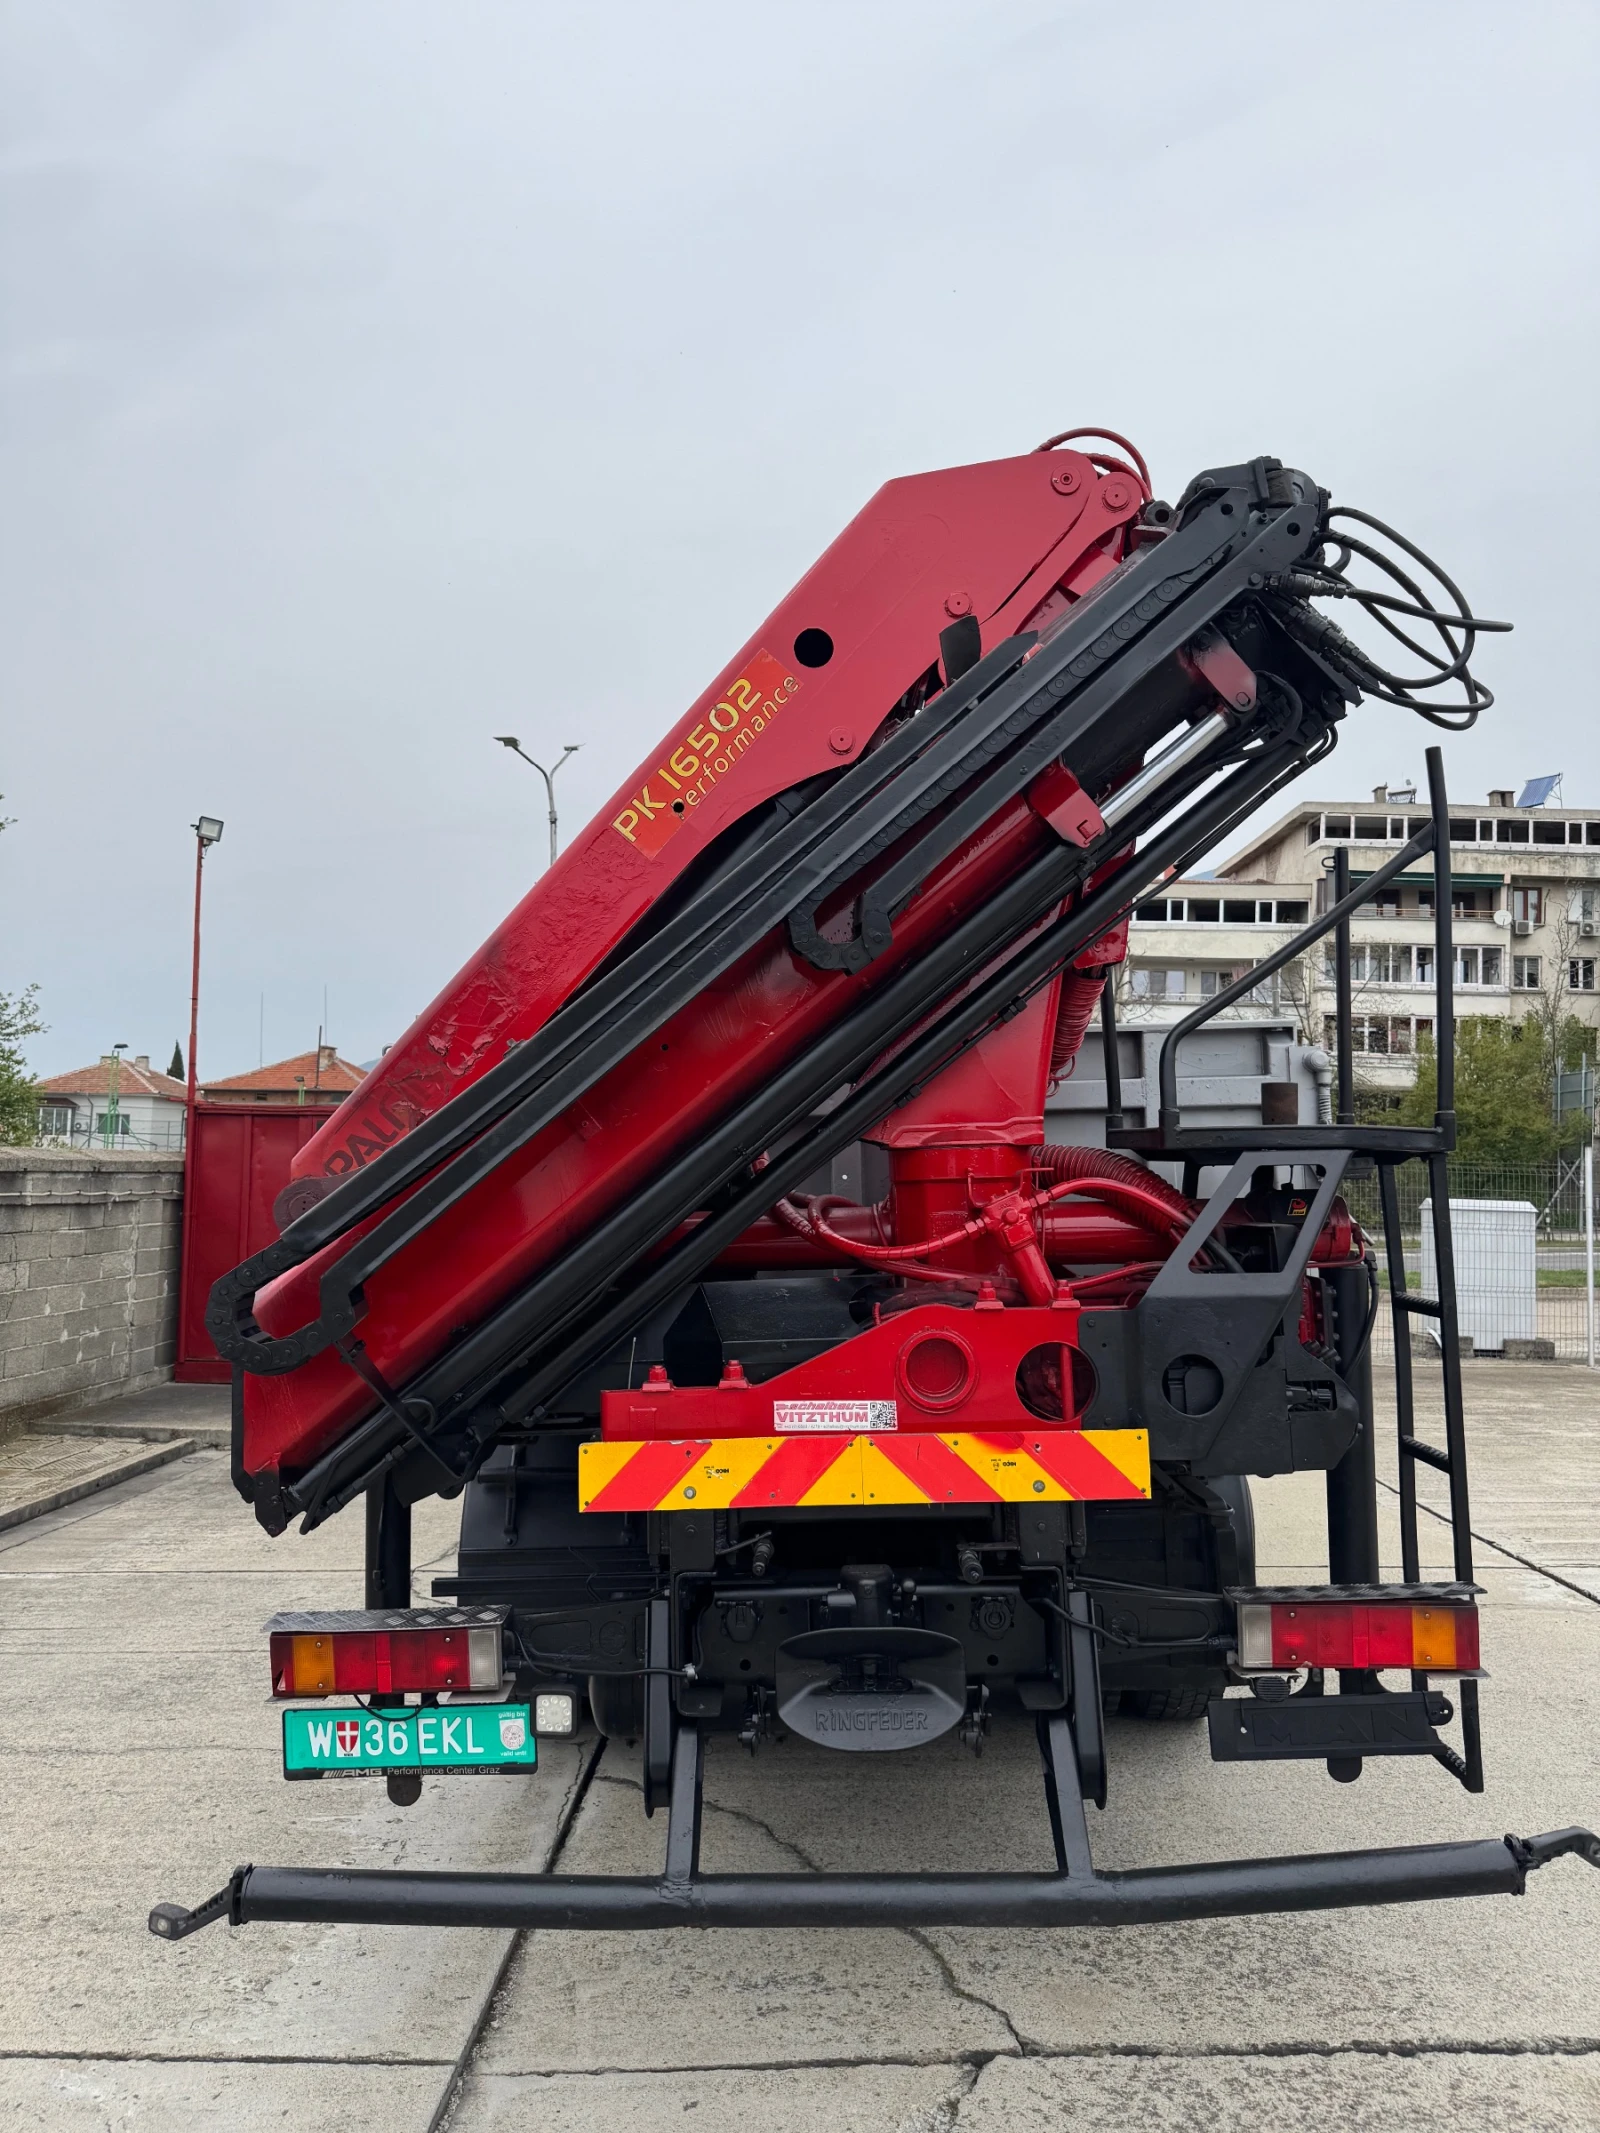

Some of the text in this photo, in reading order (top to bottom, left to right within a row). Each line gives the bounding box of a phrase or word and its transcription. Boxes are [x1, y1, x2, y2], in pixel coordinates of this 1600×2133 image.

[612, 678, 762, 842] PK 16502
[776, 1411, 869, 1423] VITZTHUM
[815, 1708, 928, 1730] RINGFEDER
[1252, 1704, 1429, 1746] MAN
[307, 1720, 333, 1757] W
[418, 1716, 485, 1754] EKL
[341, 1766, 501, 1777] AMG Performance Center Graz
